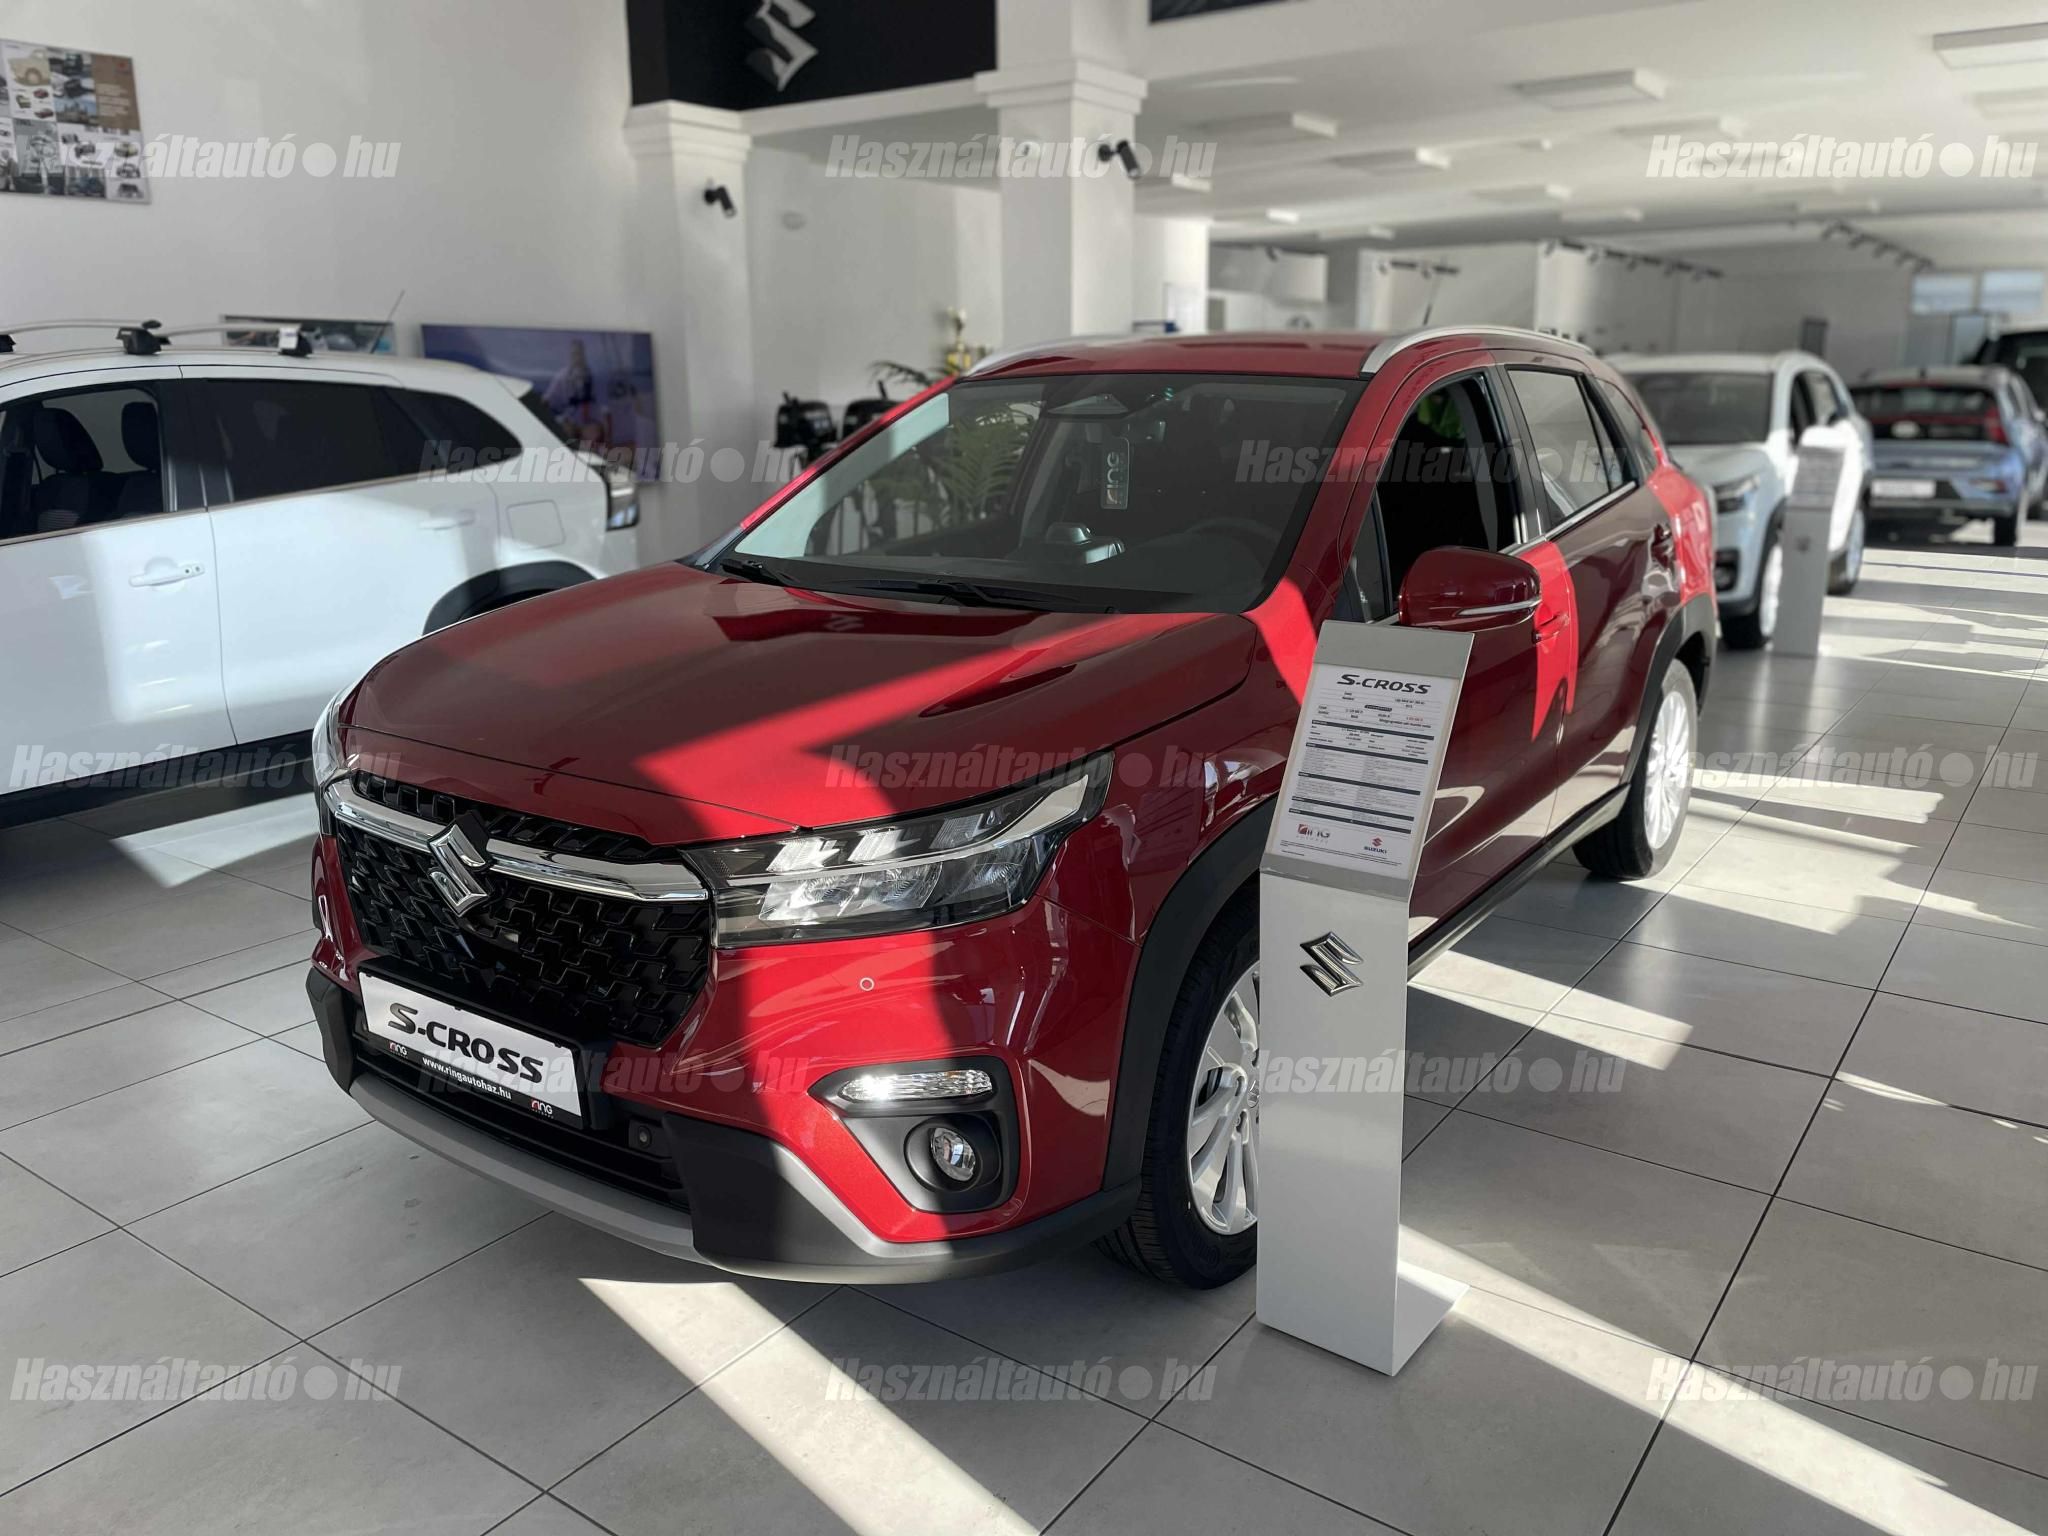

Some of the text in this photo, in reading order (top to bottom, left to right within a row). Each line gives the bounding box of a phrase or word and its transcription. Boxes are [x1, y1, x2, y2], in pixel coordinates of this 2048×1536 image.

[1337, 674, 1431, 694] S-CROSS
[388, 1002, 544, 1084] S-CROSS
[422, 1056, 512, 1101] www.ringautohaz.hu
